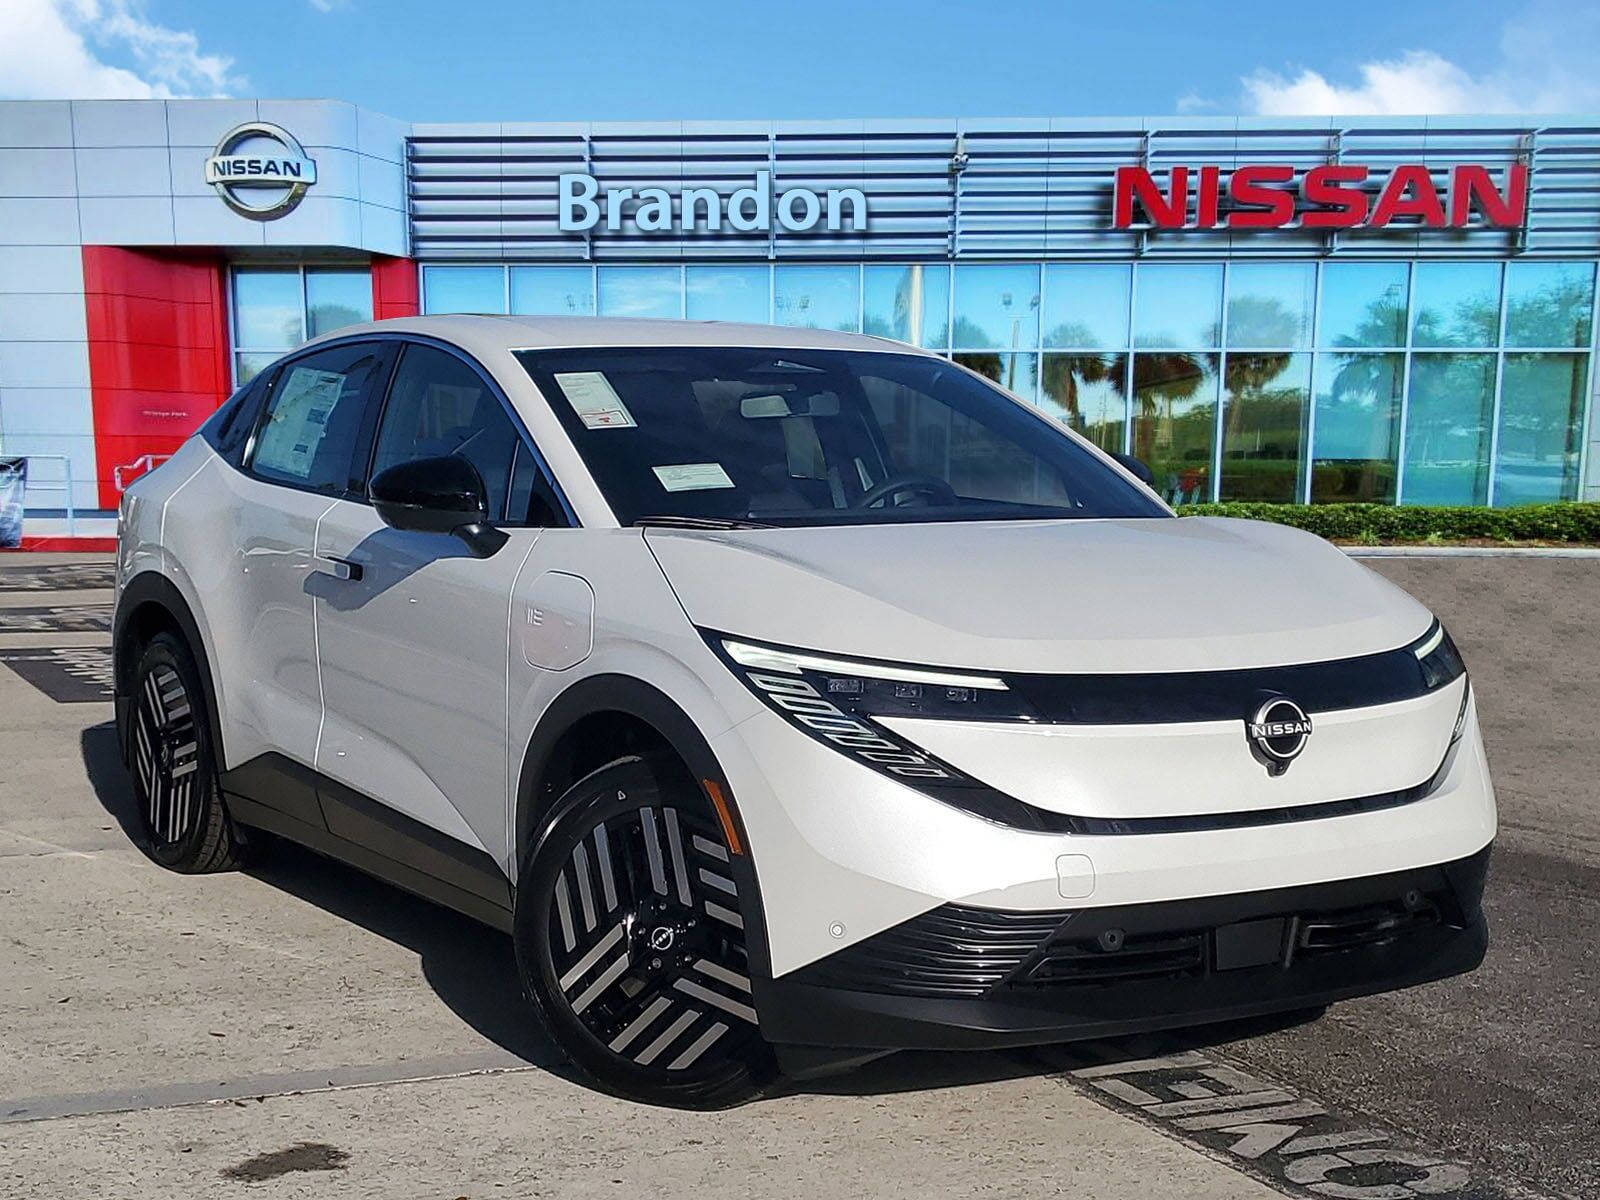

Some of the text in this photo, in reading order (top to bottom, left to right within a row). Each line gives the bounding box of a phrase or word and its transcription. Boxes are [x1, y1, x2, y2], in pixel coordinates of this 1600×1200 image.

[213, 159, 301, 177] NISSAN
[559, 170, 867, 231] Brandon
[1112, 165, 1528, 229] NISSAN
[1254, 722, 1312, 737] NISSAN
